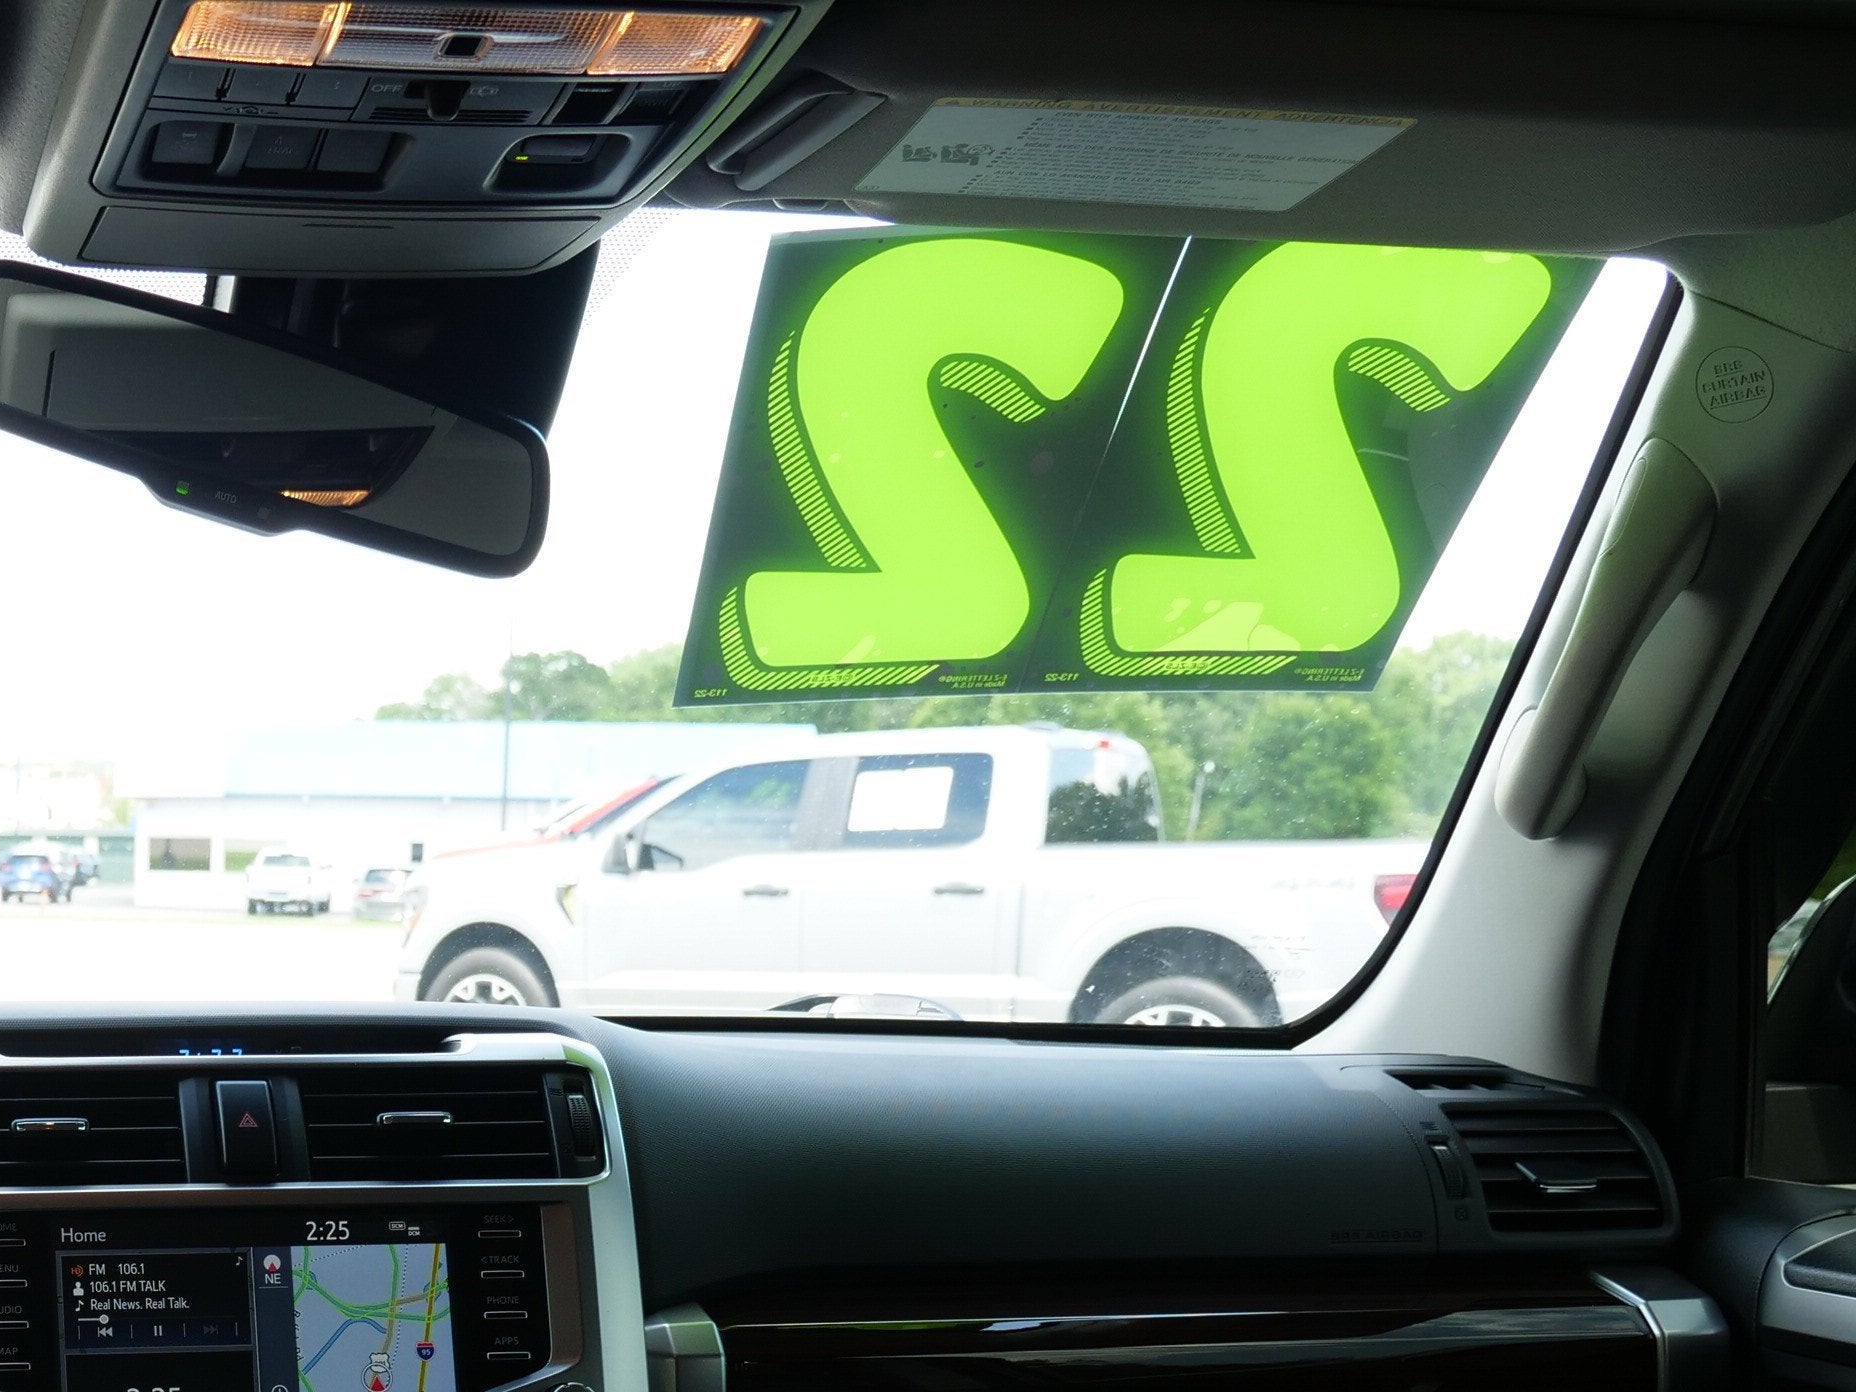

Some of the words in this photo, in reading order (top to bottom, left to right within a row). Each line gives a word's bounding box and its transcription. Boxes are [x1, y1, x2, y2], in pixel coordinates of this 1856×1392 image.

[370, 83, 402, 94] OFF
[972, 99, 1072, 109] WARNING
[214, 490, 237, 504] AUTO
[60, 1227, 107, 1243] Home
[305, 1220, 350, 1241] 2:25
[88, 1263, 106, 1275] FM
[117, 1263, 145, 1275] 106.1
[264, 1273, 282, 1285] NE
[89, 1281, 117, 1293] 106.1
[119, 1281, 137, 1293] FM
[139, 1280, 167, 1292] TALK
[90, 1299, 111, 1311] Real
[113, 1298, 143, 1310] News.
[145, 1298, 166, 1310] Real
[167, 1297, 190, 1309] Talk.
[486, 1295, 520, 1304] PHONE
[494, 1336, 519, 1345] APPS
[421, 1348, 431, 1356] 95
